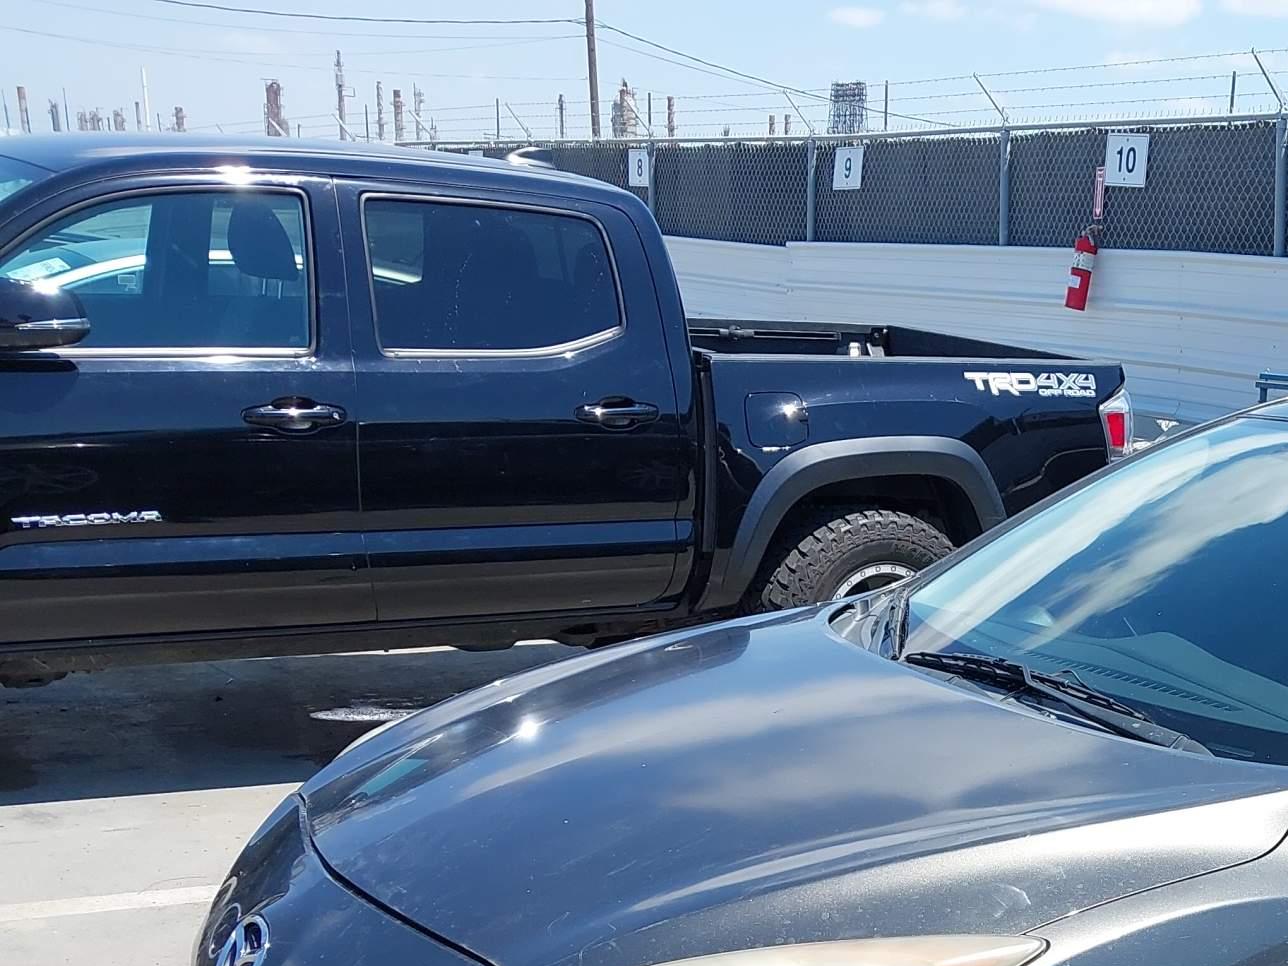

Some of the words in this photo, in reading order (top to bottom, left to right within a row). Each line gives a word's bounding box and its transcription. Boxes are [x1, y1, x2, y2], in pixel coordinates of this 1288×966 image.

[636, 158, 644, 177] 8
[843, 157, 853, 179] 9
[1116, 146, 1137, 174] 10
[963, 371, 1038, 397] TRD
[1036, 372, 1097, 390] 4X4
[1038, 388, 1062, 398] OFF
[1063, 388, 1097, 398] ROAD
[11, 510, 163, 528] TACOMA
